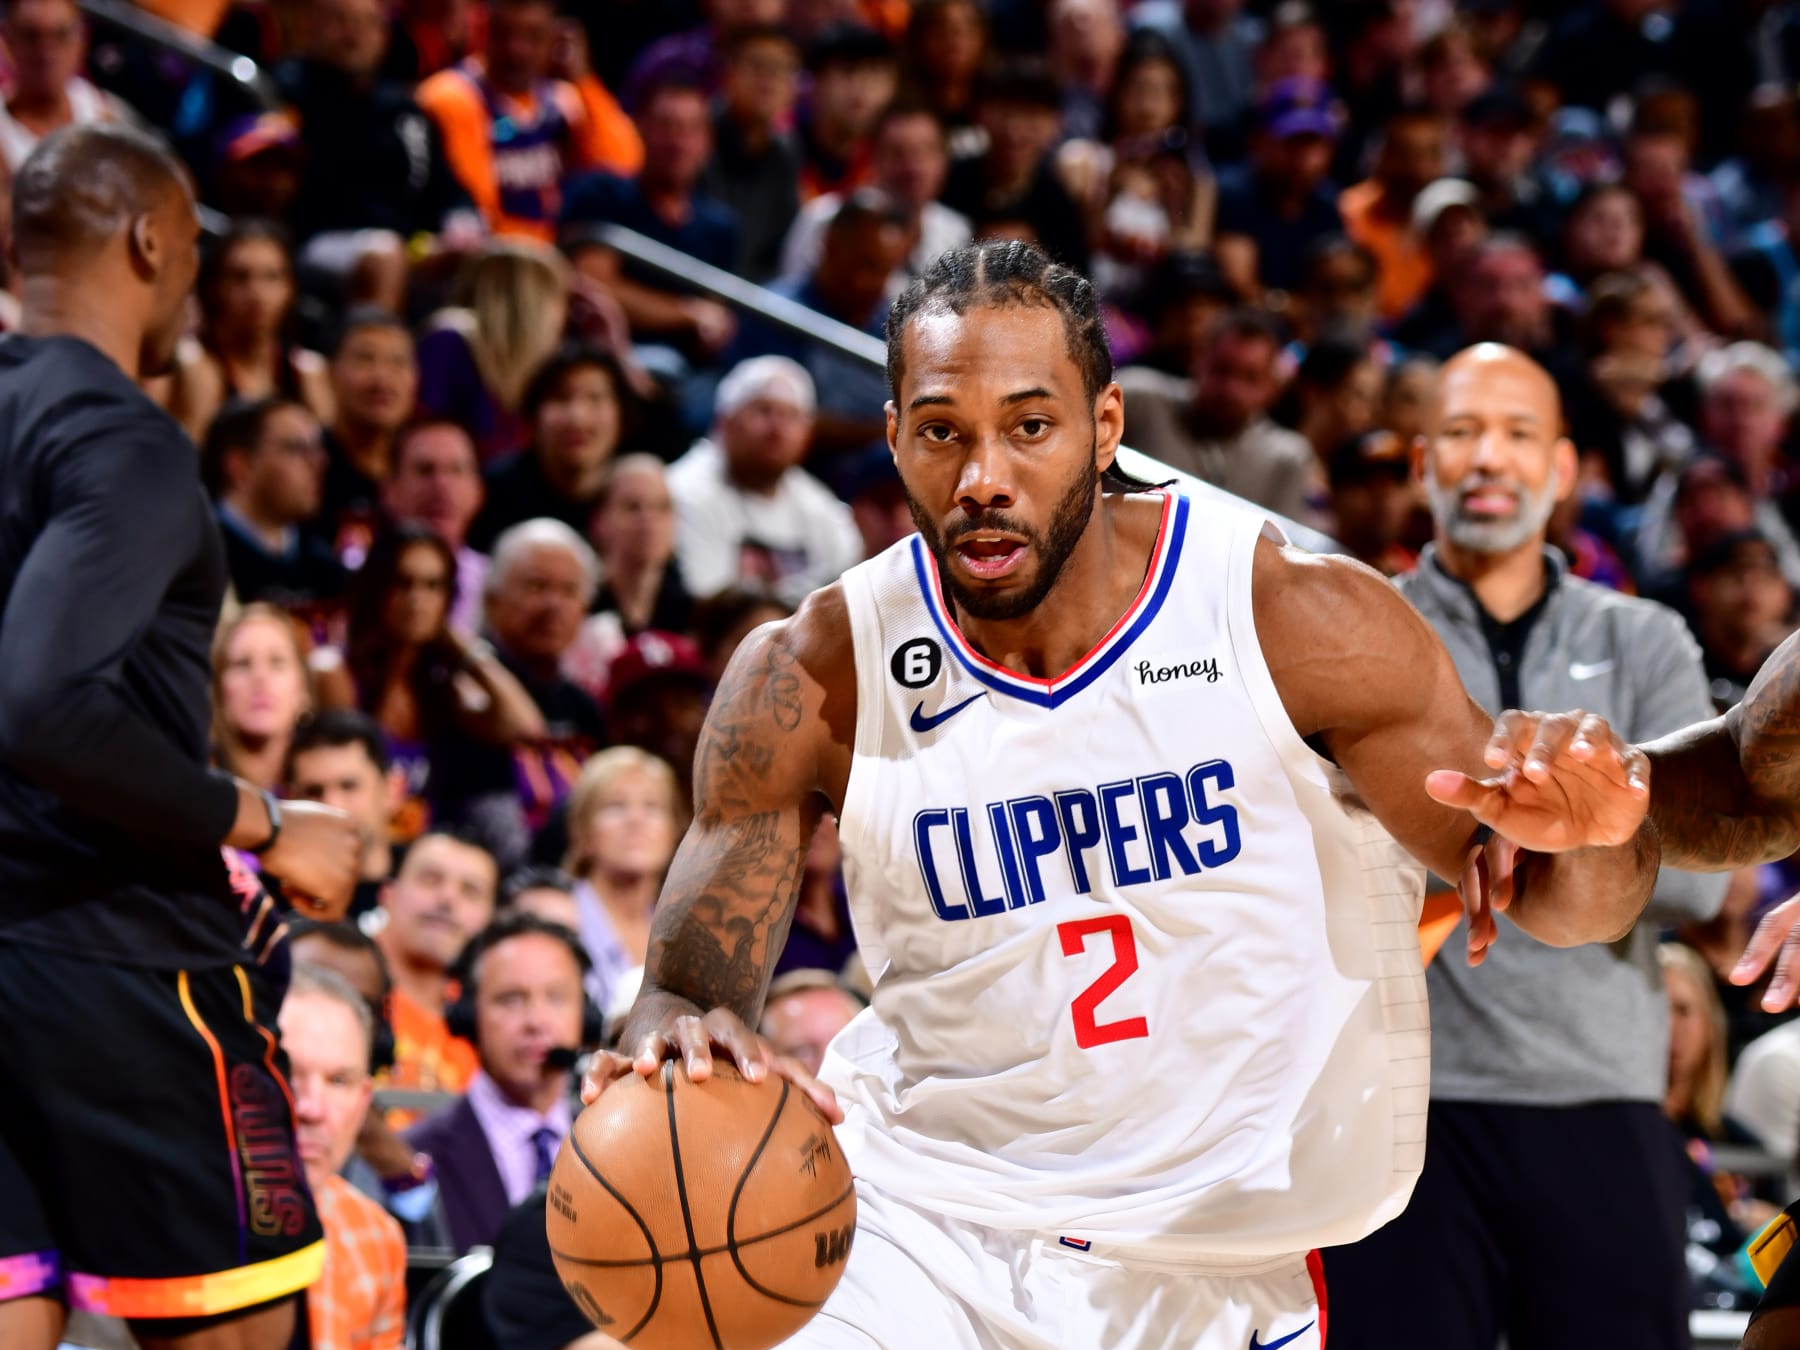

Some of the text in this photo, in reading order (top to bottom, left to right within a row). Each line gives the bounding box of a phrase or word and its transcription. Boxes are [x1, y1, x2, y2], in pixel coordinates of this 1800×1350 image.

[903, 641, 932, 683] 6
[1134, 657, 1223, 685] honey
[913, 759, 1241, 922] CLIPPERS
[1056, 914, 1149, 1049] 2
